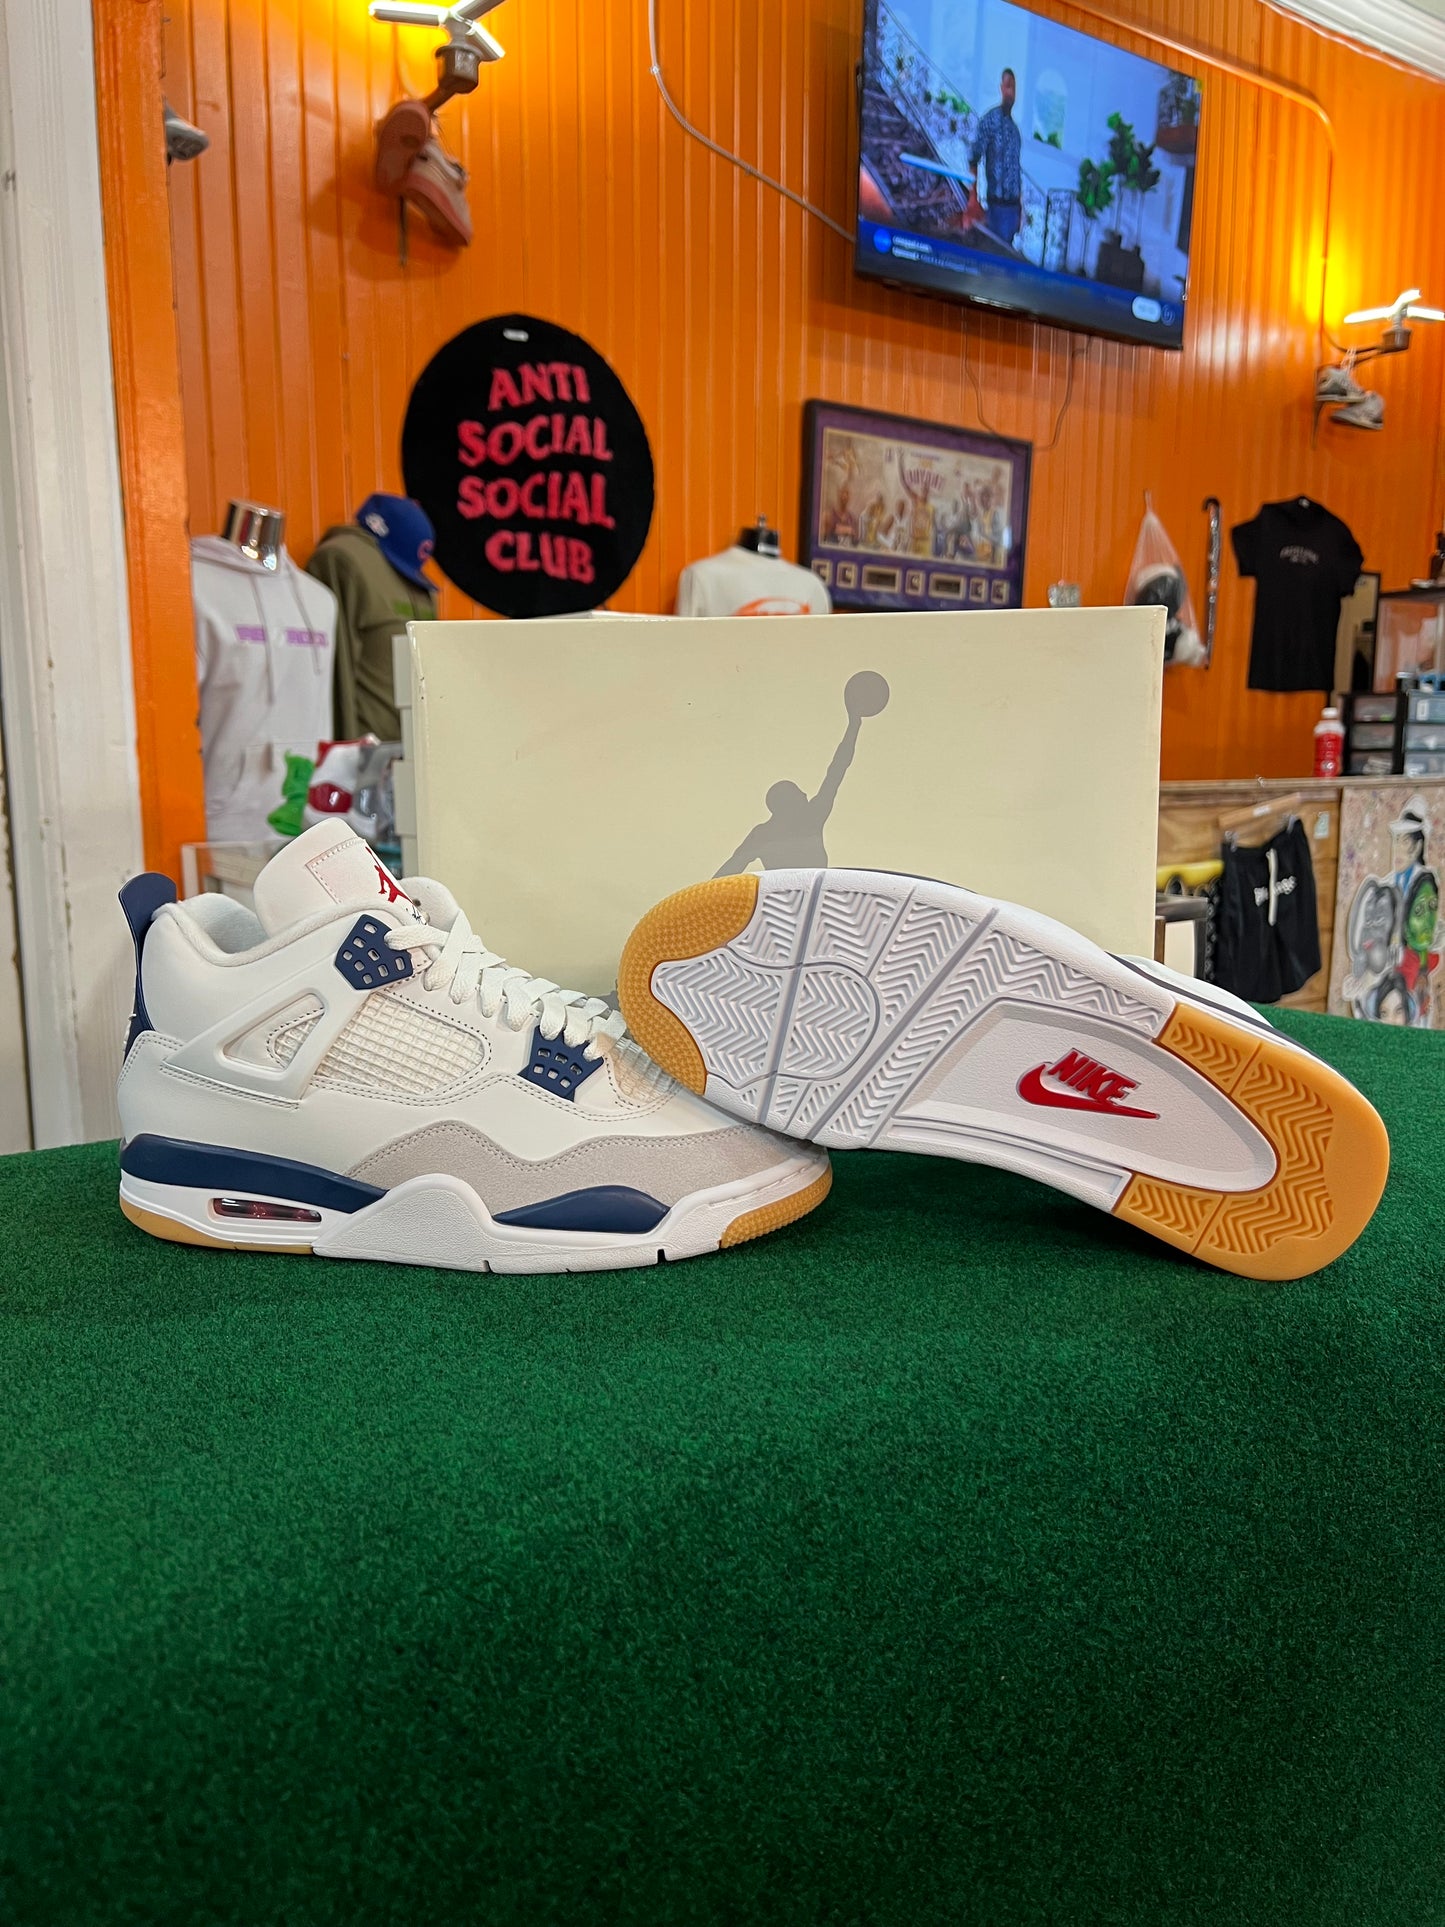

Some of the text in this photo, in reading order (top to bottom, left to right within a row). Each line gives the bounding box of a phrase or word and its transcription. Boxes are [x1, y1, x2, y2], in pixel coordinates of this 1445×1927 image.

[488, 362, 590, 411] ANTI
[457, 413, 613, 467] SOCIAL
[457, 471, 616, 529] SOCIAL
[484, 529, 595, 584] CLUB
[1048, 1051, 1138, 1104] NIKE
